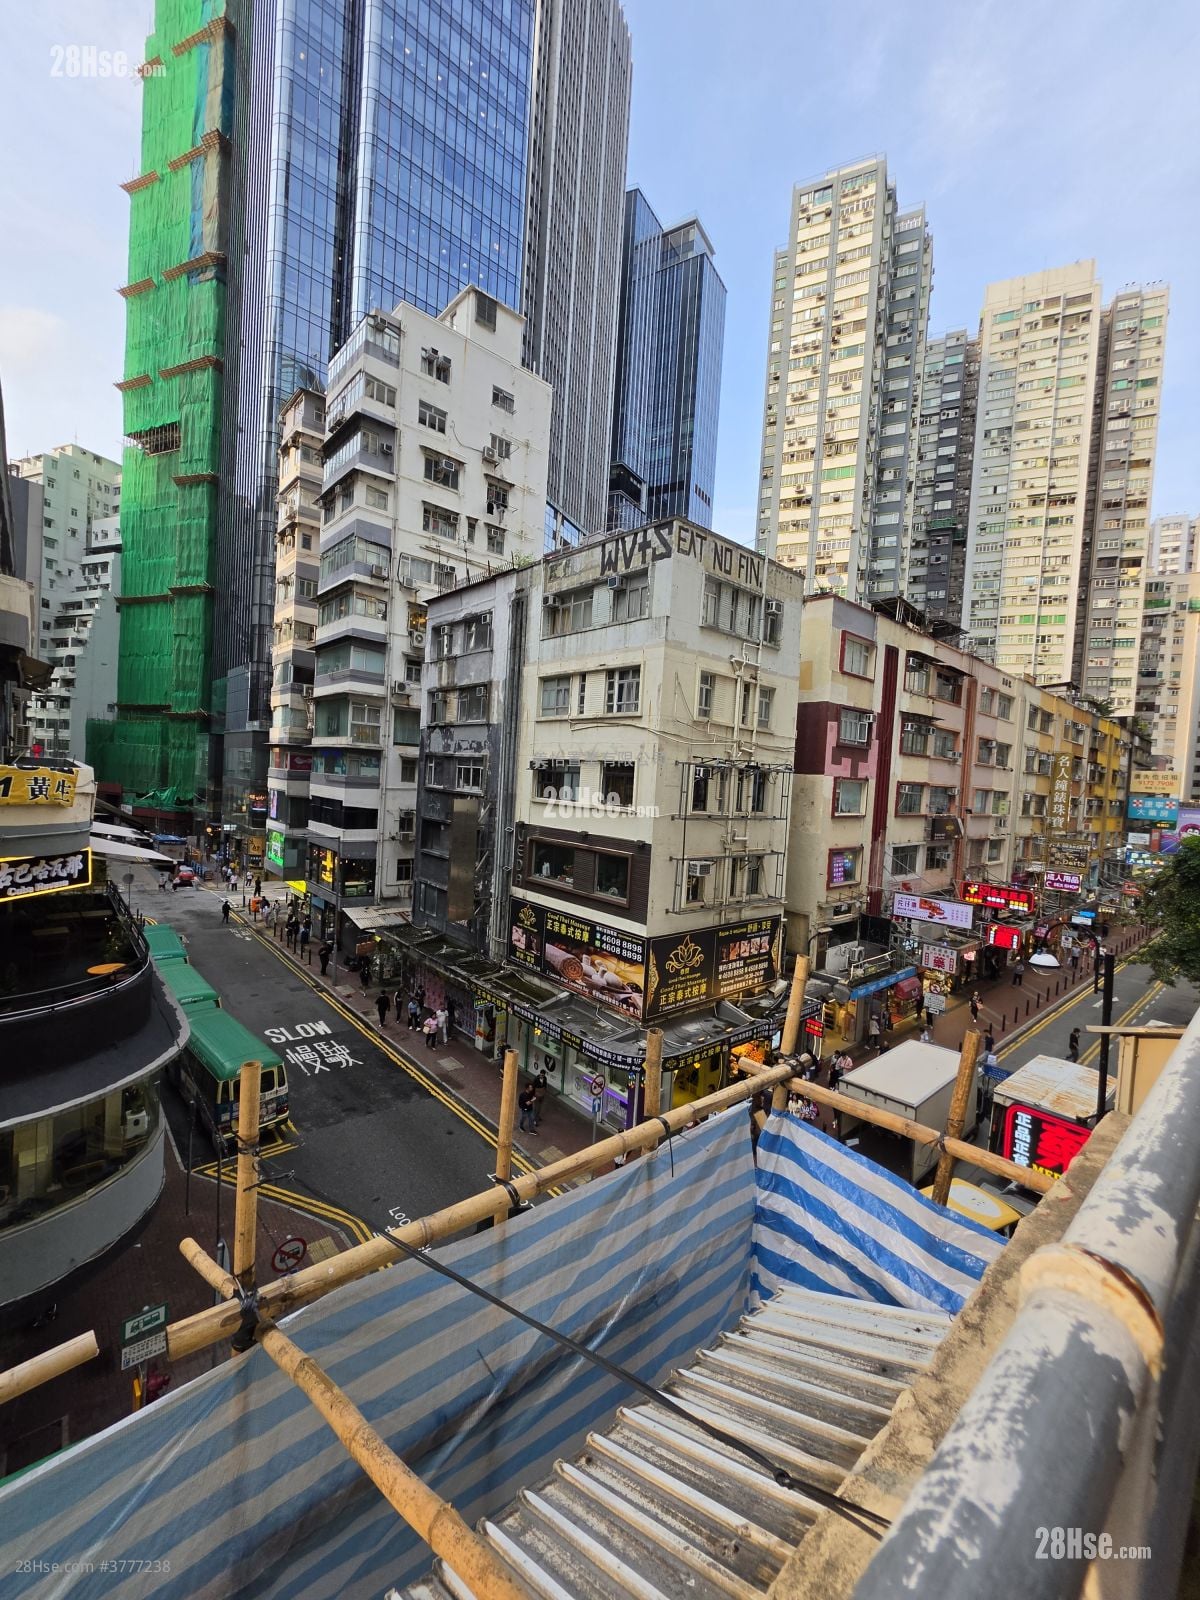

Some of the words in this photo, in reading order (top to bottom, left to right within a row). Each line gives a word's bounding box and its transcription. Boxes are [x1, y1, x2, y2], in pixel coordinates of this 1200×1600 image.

[678, 525, 707, 562] EAT
[713, 539, 733, 576] NO
[26, 776, 71, 802] 黃生
[1047, 873, 1079, 884] 成人用品
[602, 935, 621, 947] 4608
[622, 941, 642, 953] 8898
[602, 943, 621, 955] 4608
[622, 949, 642, 962] 8898
[659, 983, 707, 1006] 正宗泰式按摩
[264, 1021, 332, 1044] SLOW
